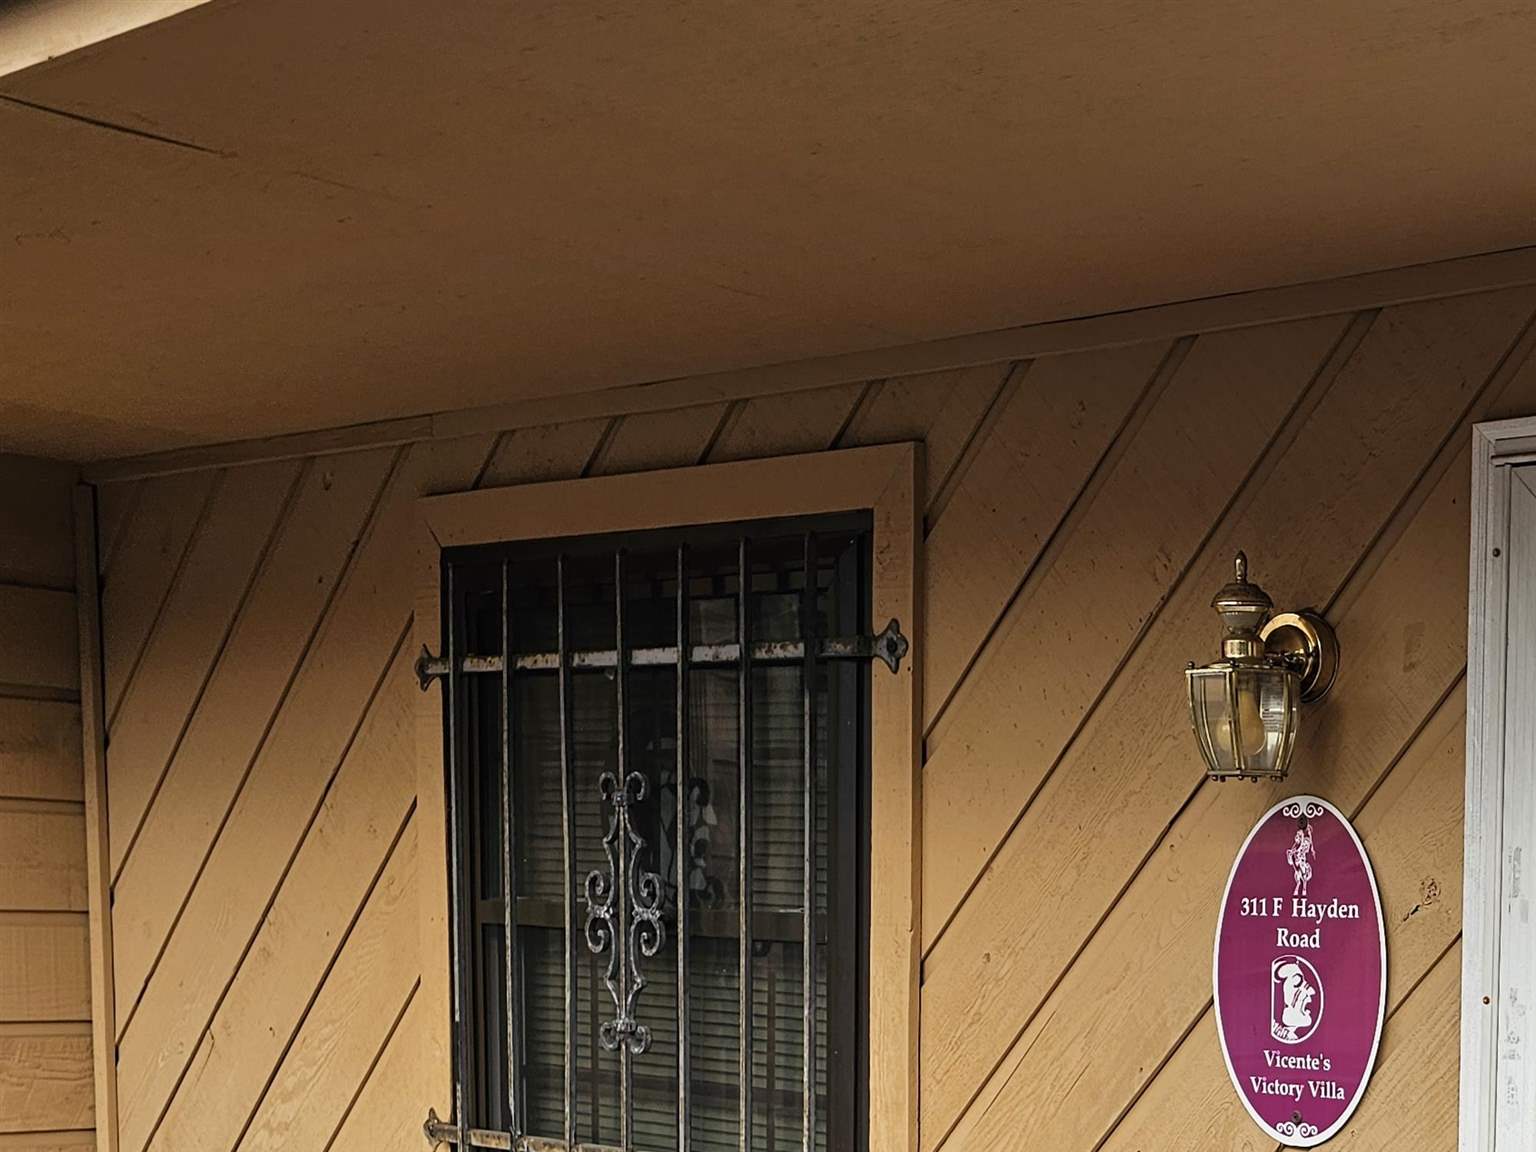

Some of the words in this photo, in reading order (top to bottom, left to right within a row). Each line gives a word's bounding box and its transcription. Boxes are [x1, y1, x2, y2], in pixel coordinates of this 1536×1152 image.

[1240, 897, 1268, 917] 311
[1272, 897, 1284, 917] F
[1291, 898, 1360, 925] Hayden
[1276, 927, 1321, 949] Road
[1263, 1050, 1331, 1071] Vicente's
[1249, 1076, 1304, 1102] Victory
[1308, 1080, 1345, 1100] Villa
